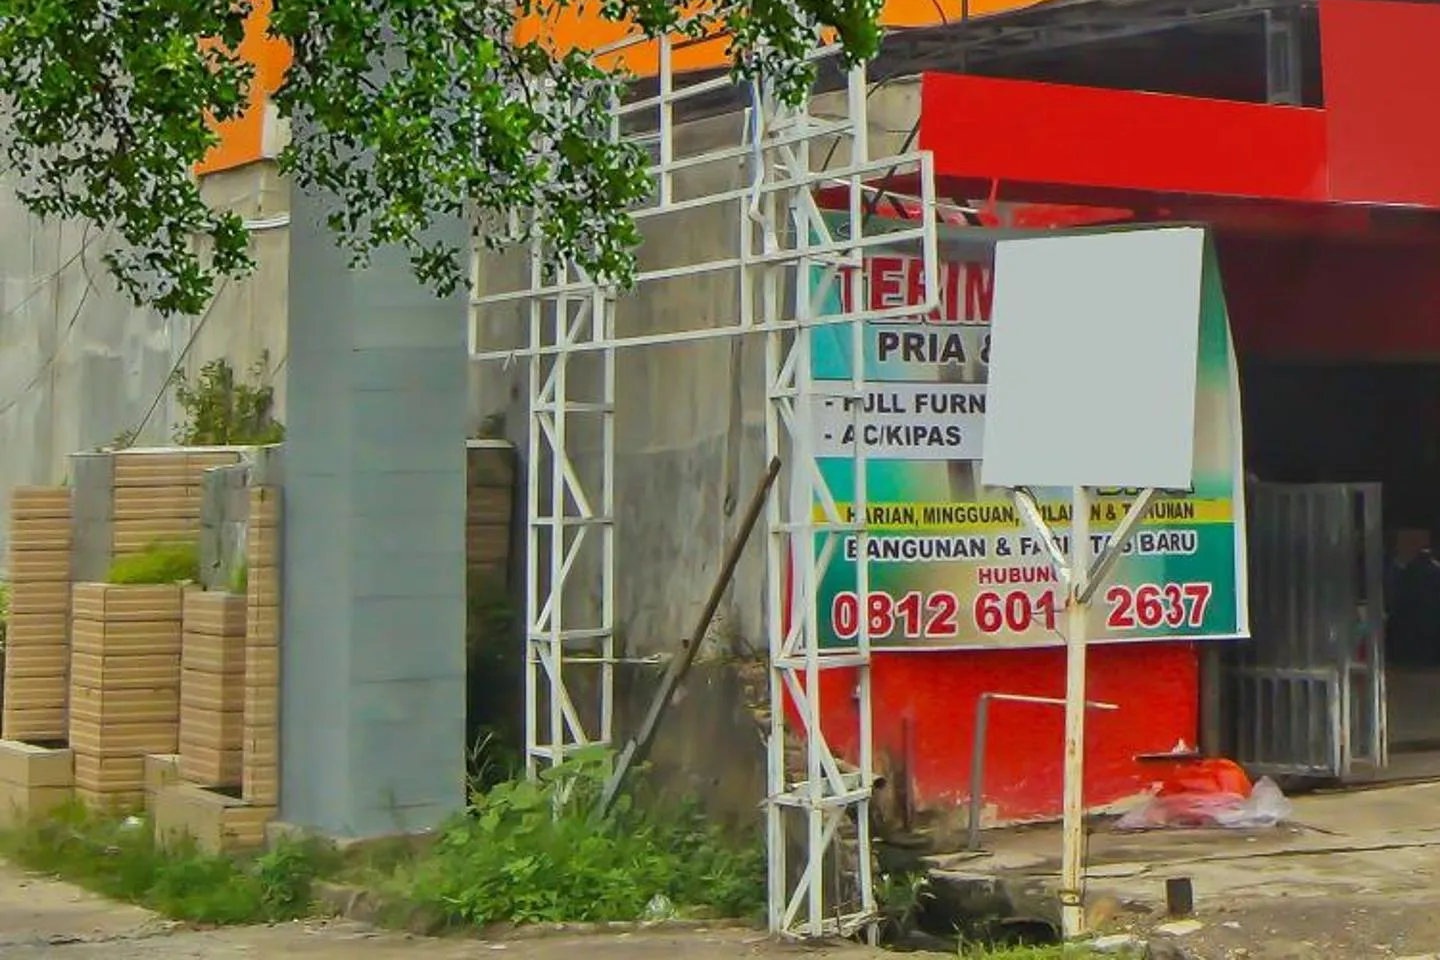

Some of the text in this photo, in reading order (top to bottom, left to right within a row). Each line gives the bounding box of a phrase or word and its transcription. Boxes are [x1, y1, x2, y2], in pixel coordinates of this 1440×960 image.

[879, 332, 966, 363] PRIA
[996, 538, 1011, 557] &
[1140, 533, 1196, 552] BARU
[978, 565, 1058, 584] HUBUN
[834, 592, 958, 637] 0812
[1106, 583, 1212, 627] 2637
